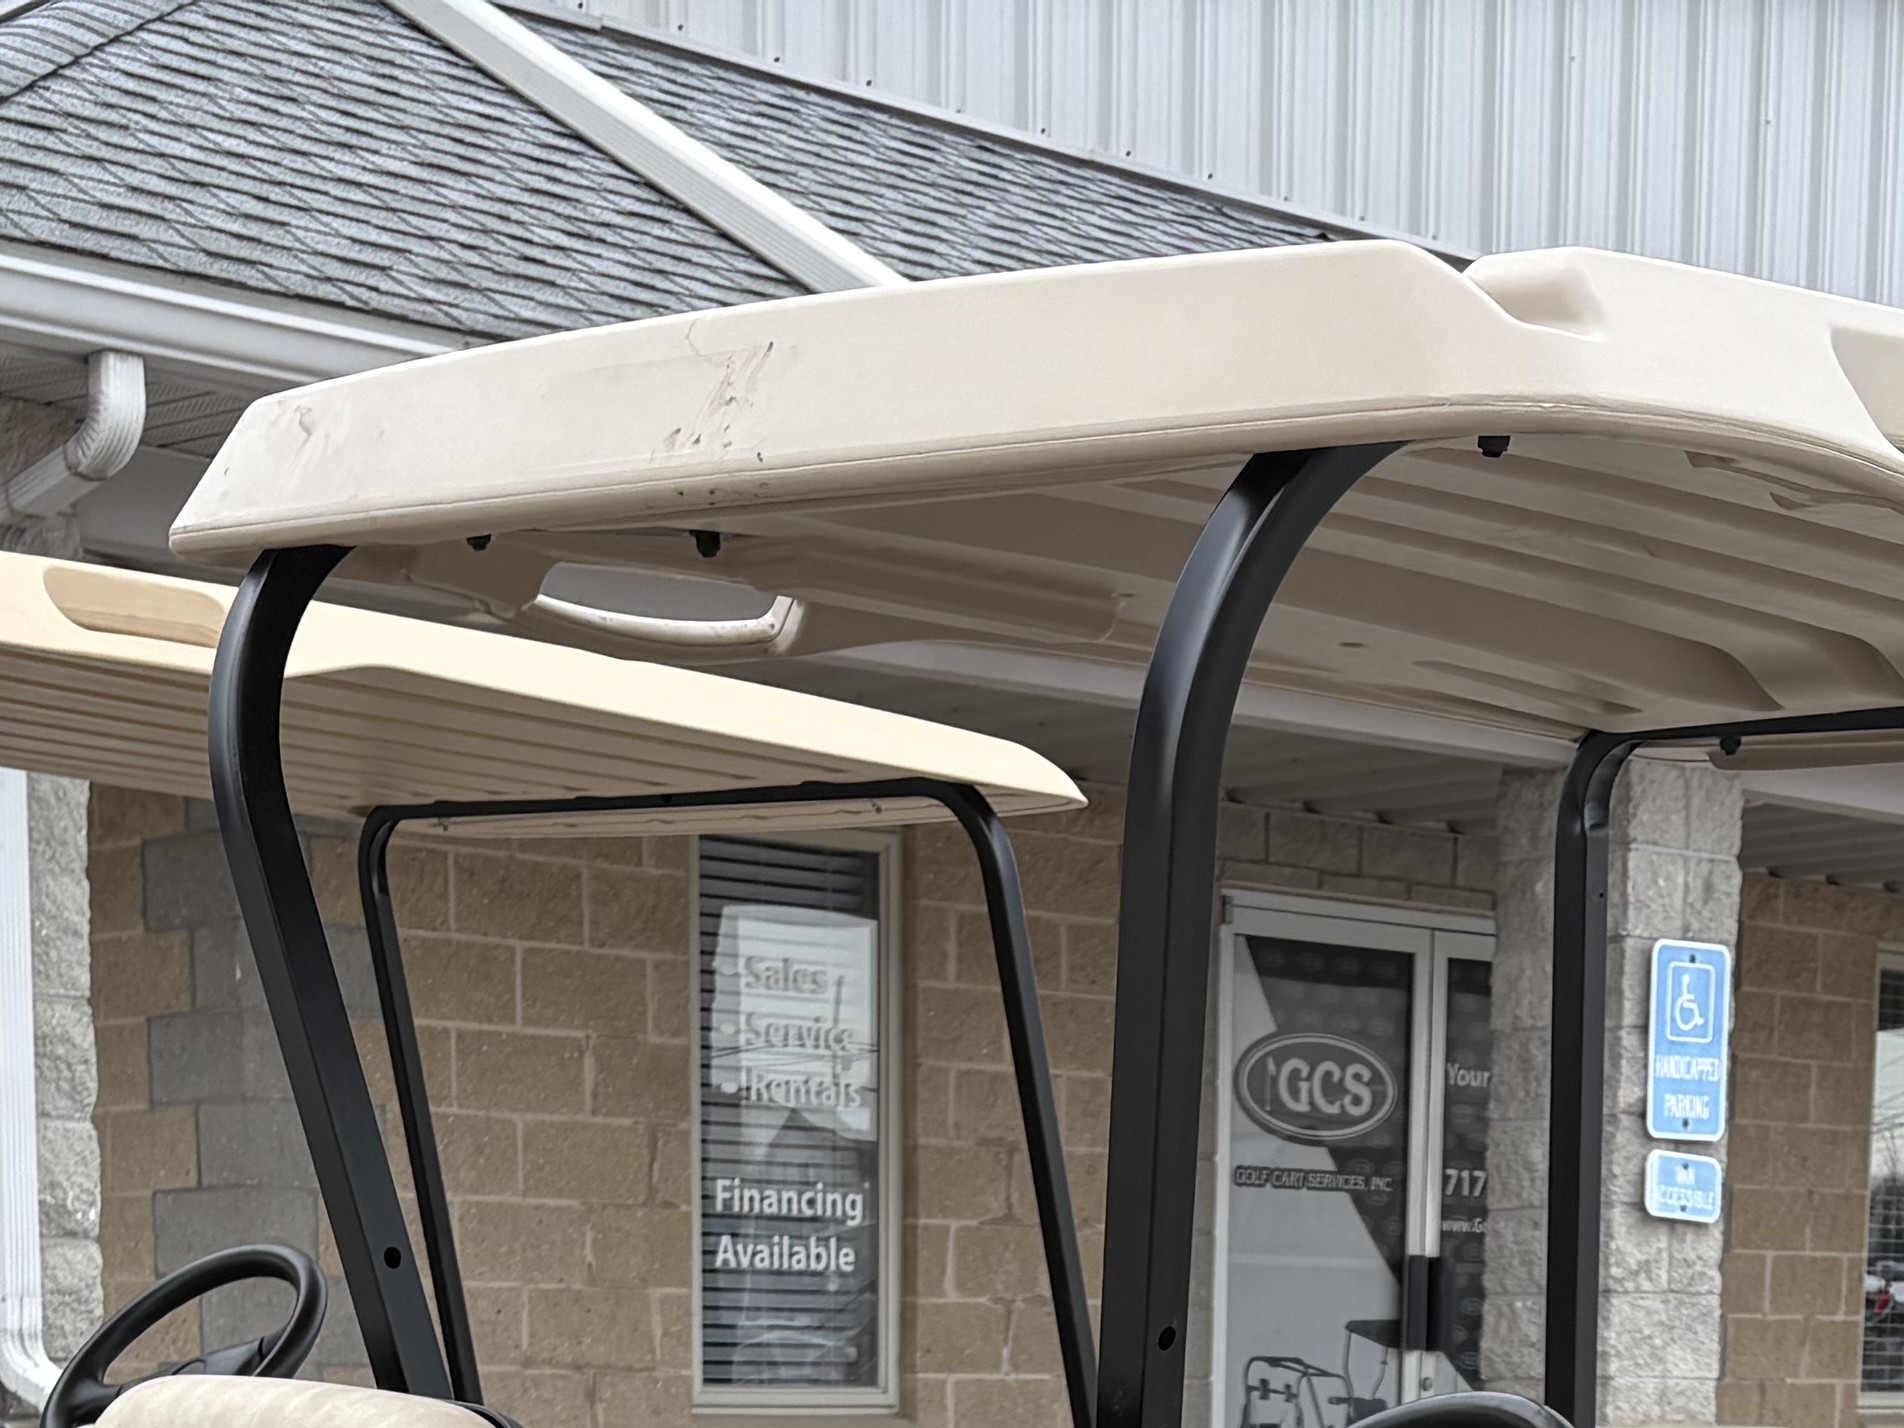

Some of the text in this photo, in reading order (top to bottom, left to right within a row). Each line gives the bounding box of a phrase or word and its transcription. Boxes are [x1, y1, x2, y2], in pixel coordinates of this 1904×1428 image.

[746, 955, 830, 995] Sales
[746, 1012, 854, 1050] Service
[1278, 1057, 1374, 1117] GCS
[1447, 1062, 1491, 1088] Your
[1655, 1054, 1721, 1082] HANDICAPPED
[746, 1067, 863, 1108] Rentals
[1663, 1093, 1710, 1121] PARKING
[1236, 1168, 1271, 1185] GOLF
[1272, 1170, 1305, 1187] CART
[715, 1177, 864, 1227] Financing
[714, 1234, 857, 1272] Available
